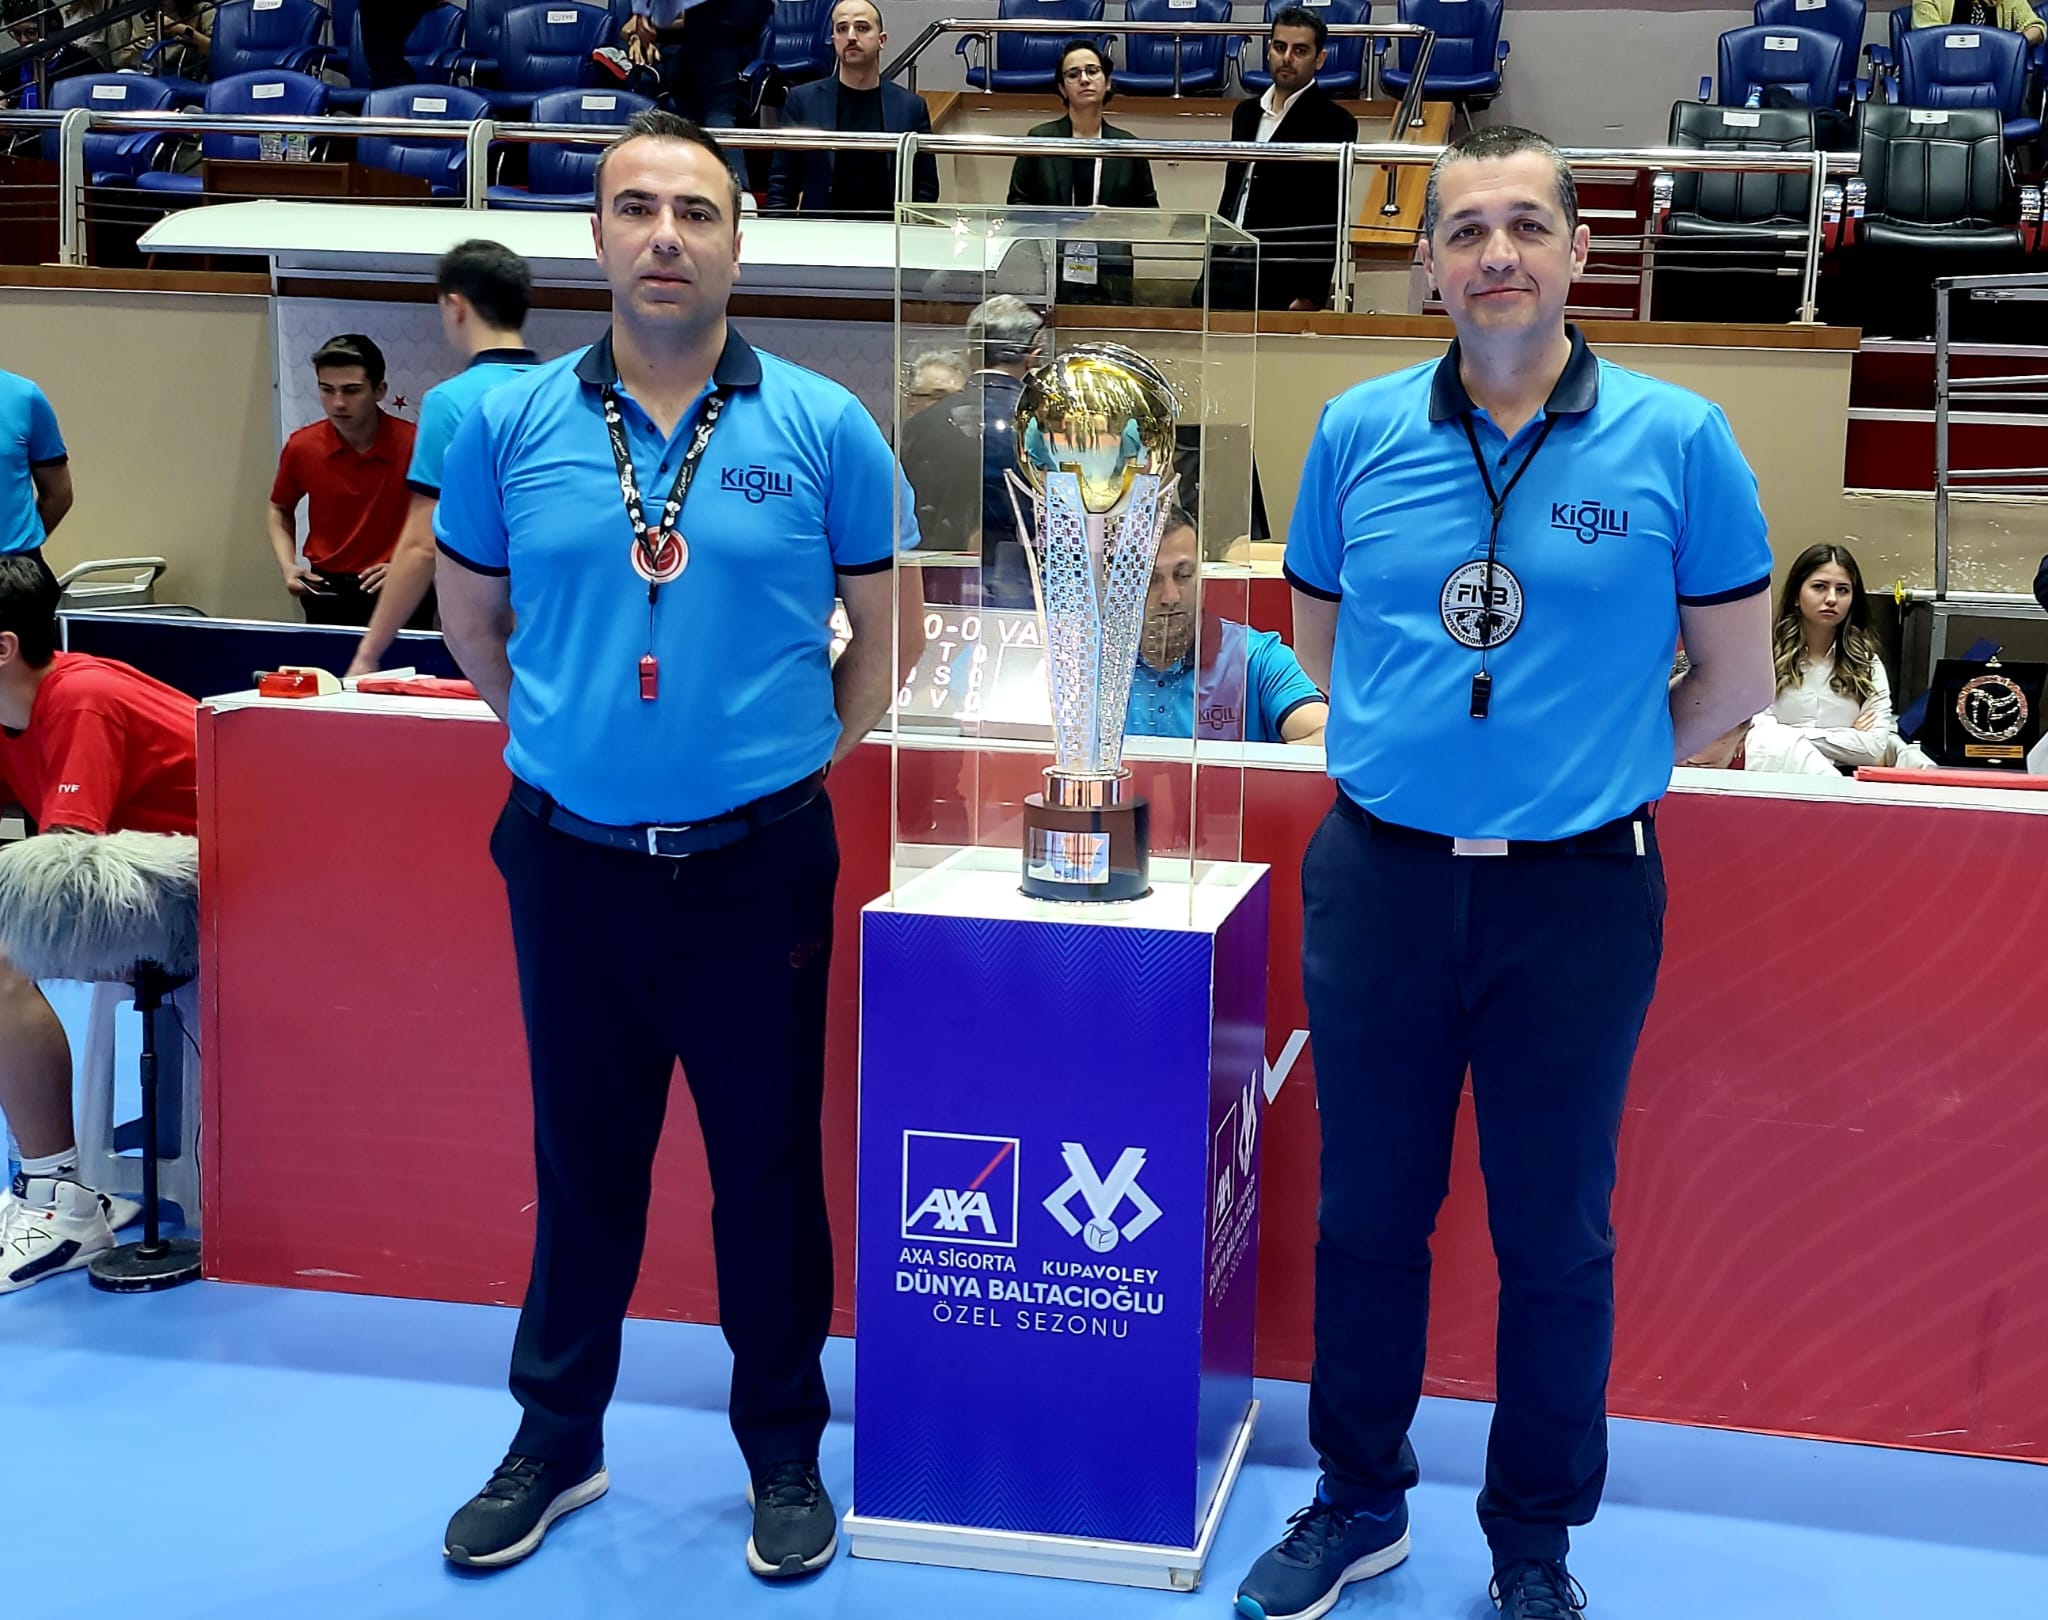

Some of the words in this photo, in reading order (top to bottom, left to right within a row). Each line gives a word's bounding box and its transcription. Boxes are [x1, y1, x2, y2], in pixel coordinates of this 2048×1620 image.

[998, 618, 1043, 646] VA
[905, 1188, 998, 1235] AXA
[899, 1247, 934, 1265] AXA
[938, 1248, 1016, 1273] SİGORTA
[1042, 1260, 1159, 1285] KUPAVOLEY
[895, 1268, 982, 1299] DÜNYA
[988, 1278, 1164, 1315] BALTACIOĞLU
[932, 1300, 1002, 1327] ÖZEL
[1016, 1310, 1128, 1338] SEZONU
